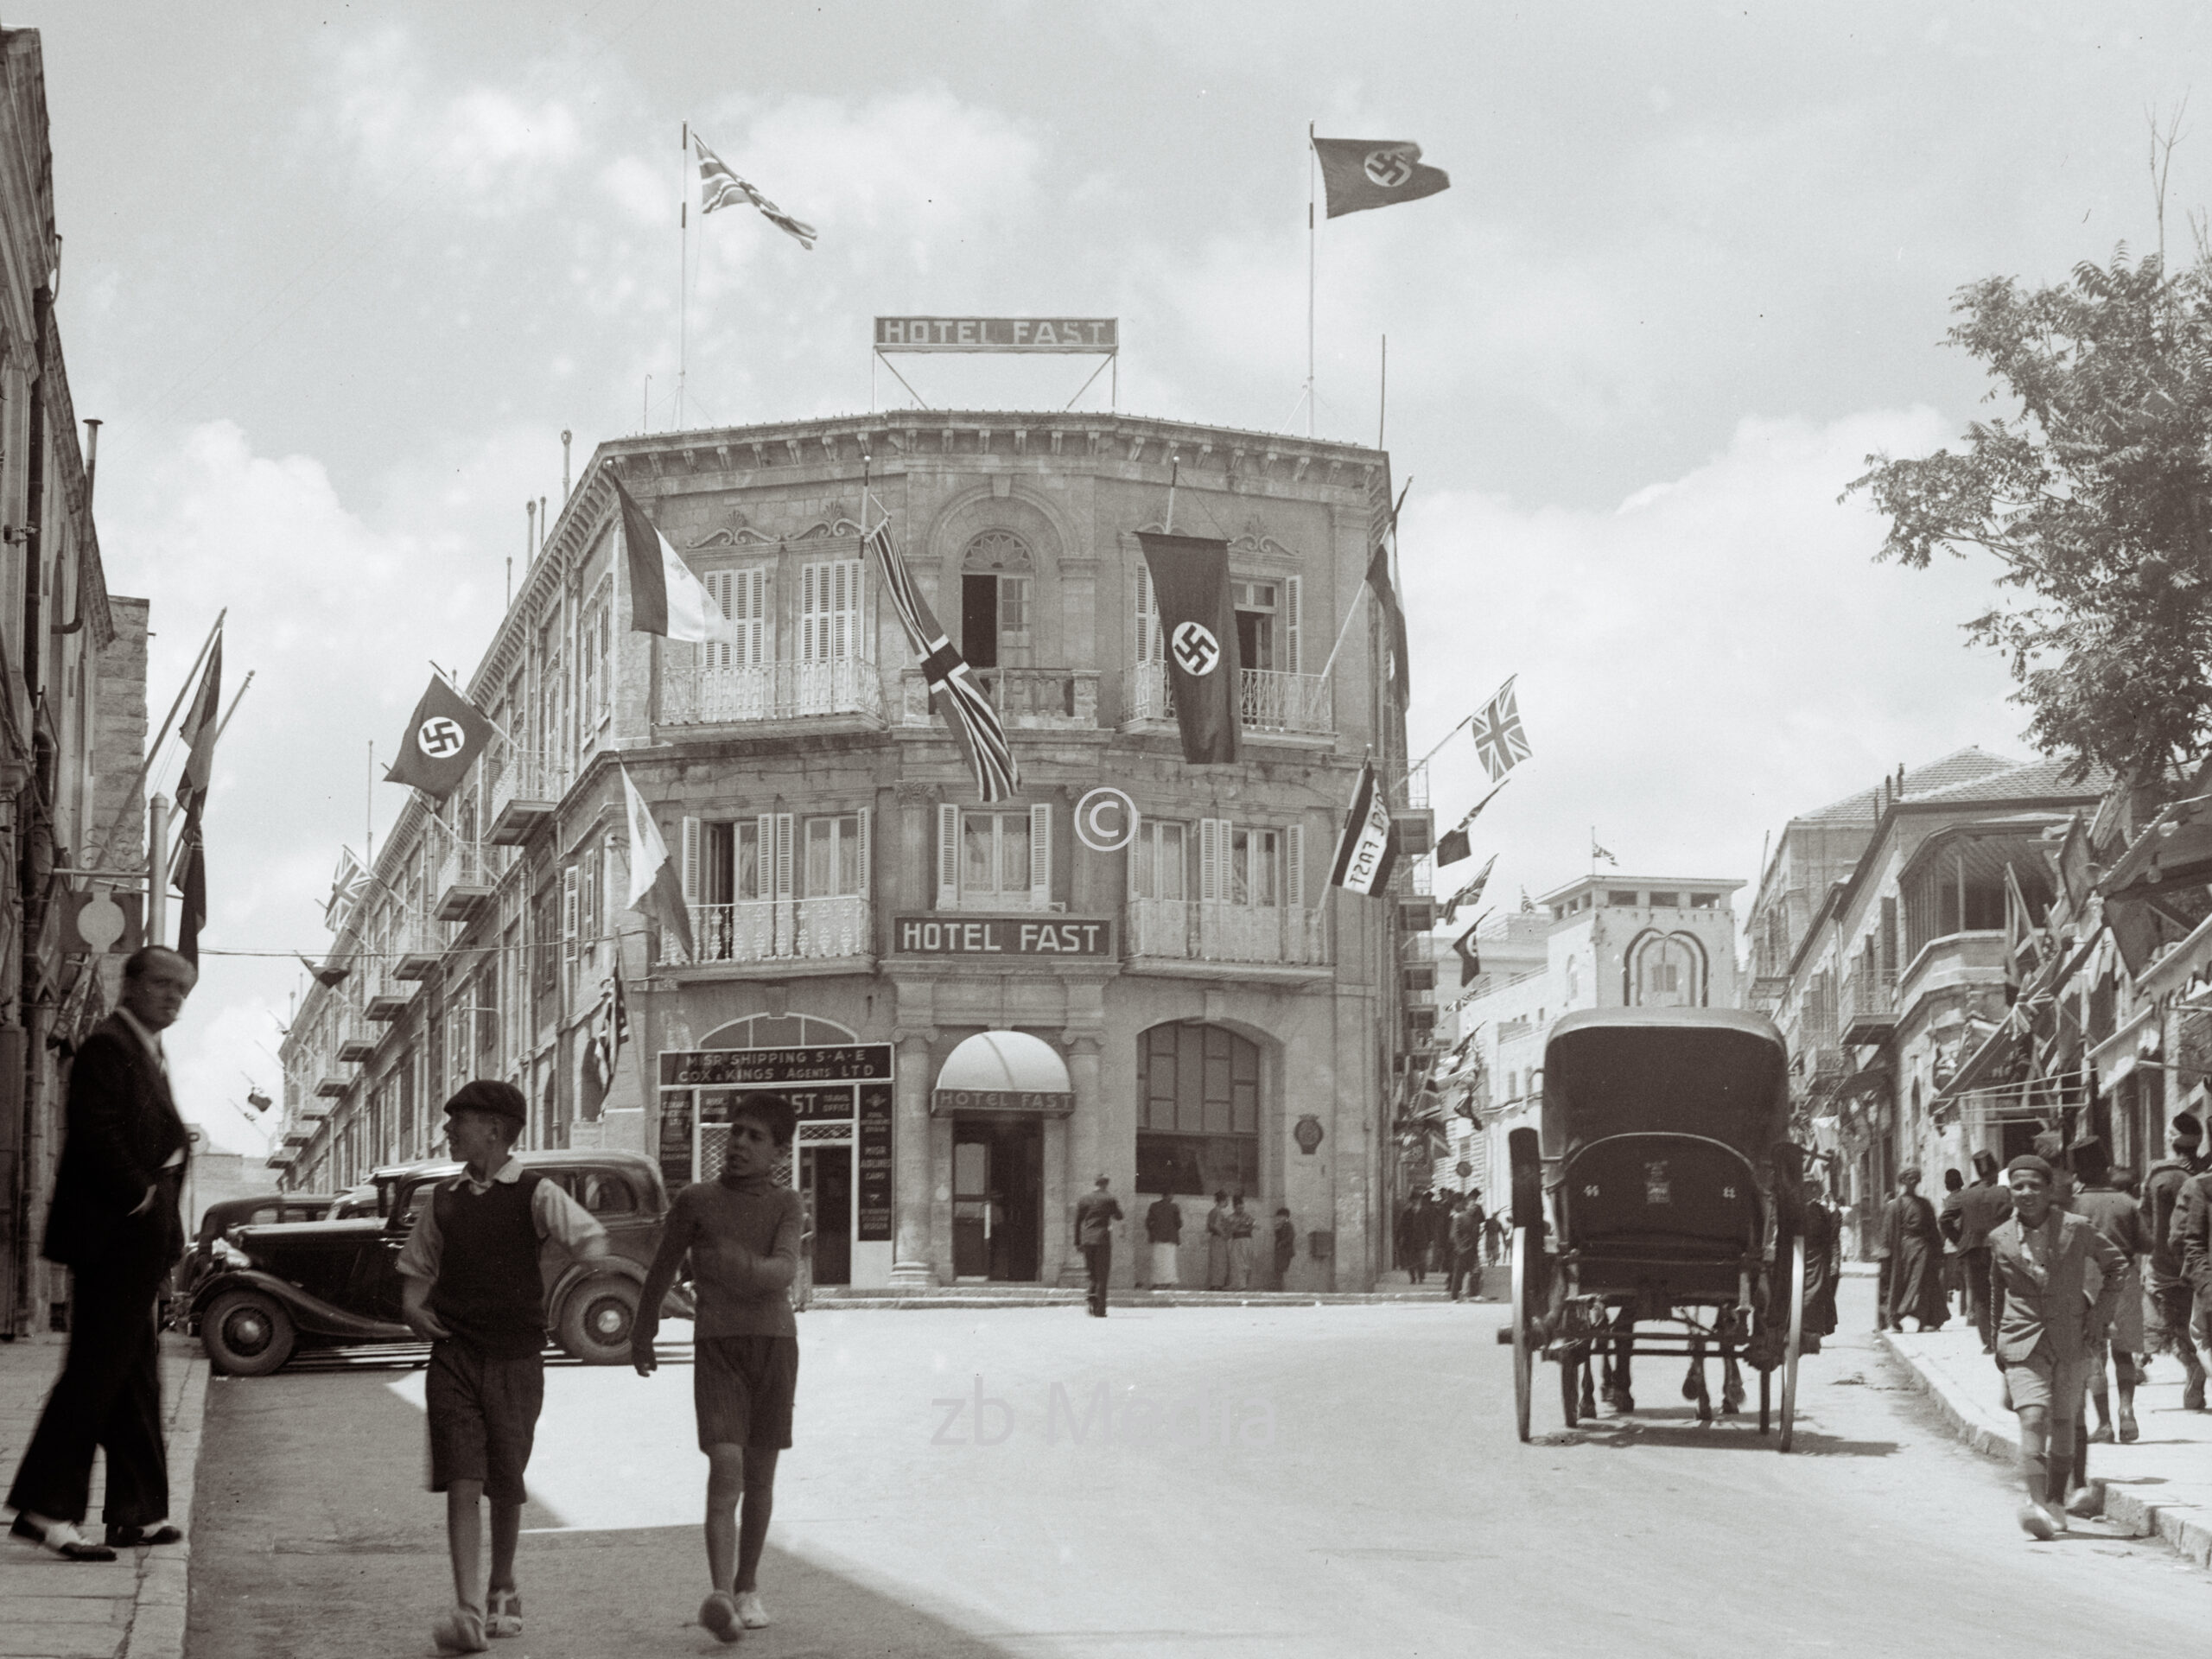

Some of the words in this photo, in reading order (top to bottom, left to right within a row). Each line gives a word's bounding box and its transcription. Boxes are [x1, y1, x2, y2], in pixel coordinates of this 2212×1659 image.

[884, 320, 994, 344] HOTEL
[1013, 321, 1105, 345] FAST
[903, 922, 1001, 950] HOTEL
[1020, 925, 1100, 951] FAST
[731, 1052, 808, 1065] SHIPPING
[678, 1070, 711, 1083] COX
[726, 1068, 775, 1081] KINGS
[842, 1065, 874, 1077] LTD
[940, 1091, 1007, 1106] HOTEL
[1021, 1093, 1072, 1108] FAST
